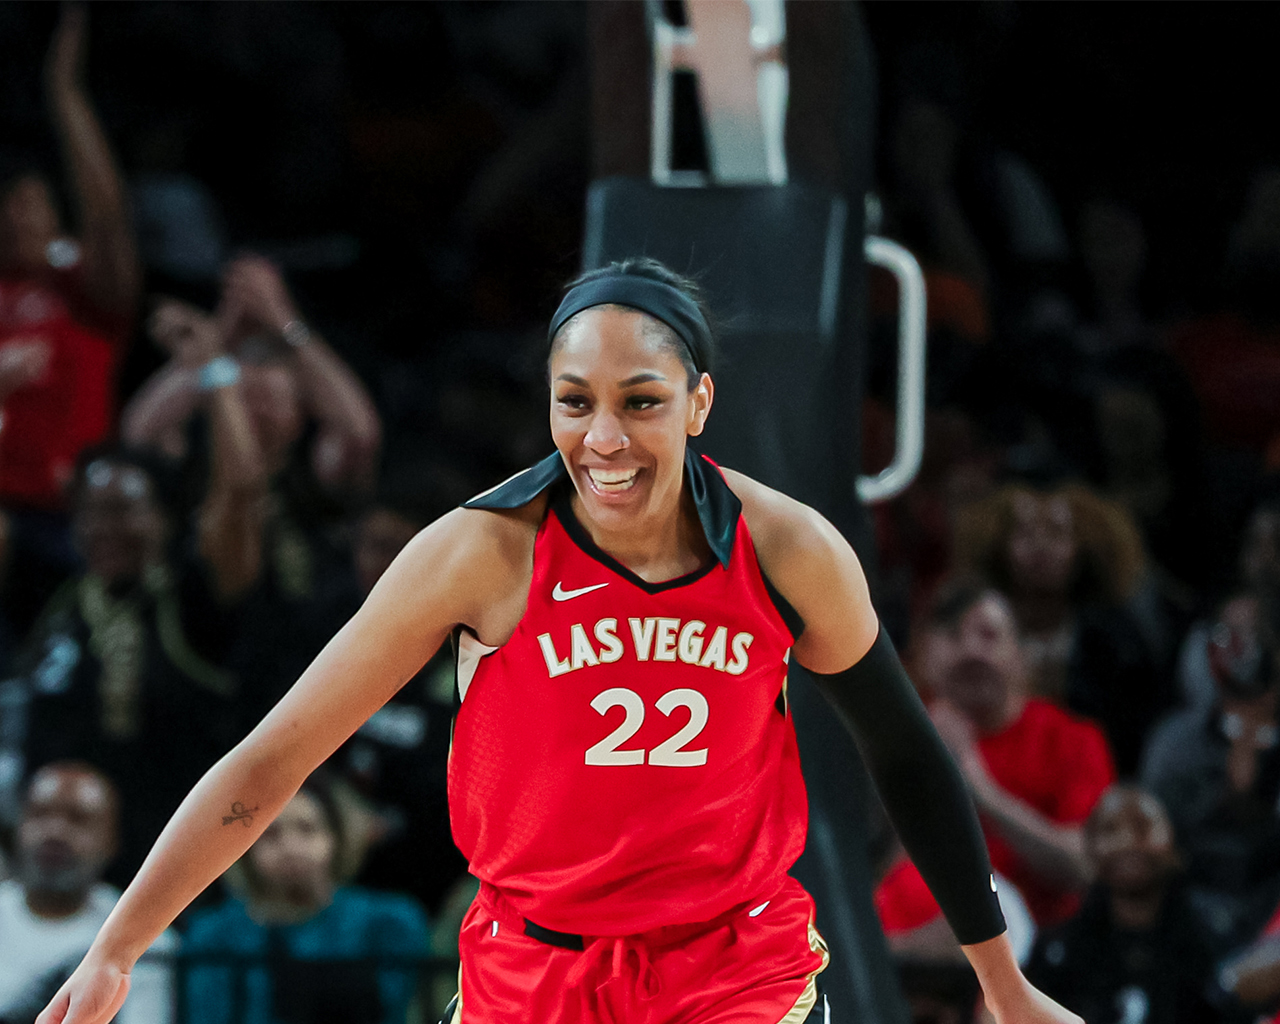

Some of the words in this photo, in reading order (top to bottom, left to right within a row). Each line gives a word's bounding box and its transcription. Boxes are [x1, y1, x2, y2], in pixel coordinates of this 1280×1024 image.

[536, 617, 624, 678] LAS
[627, 616, 755, 676] VEGAS
[584, 687, 710, 768] 22
